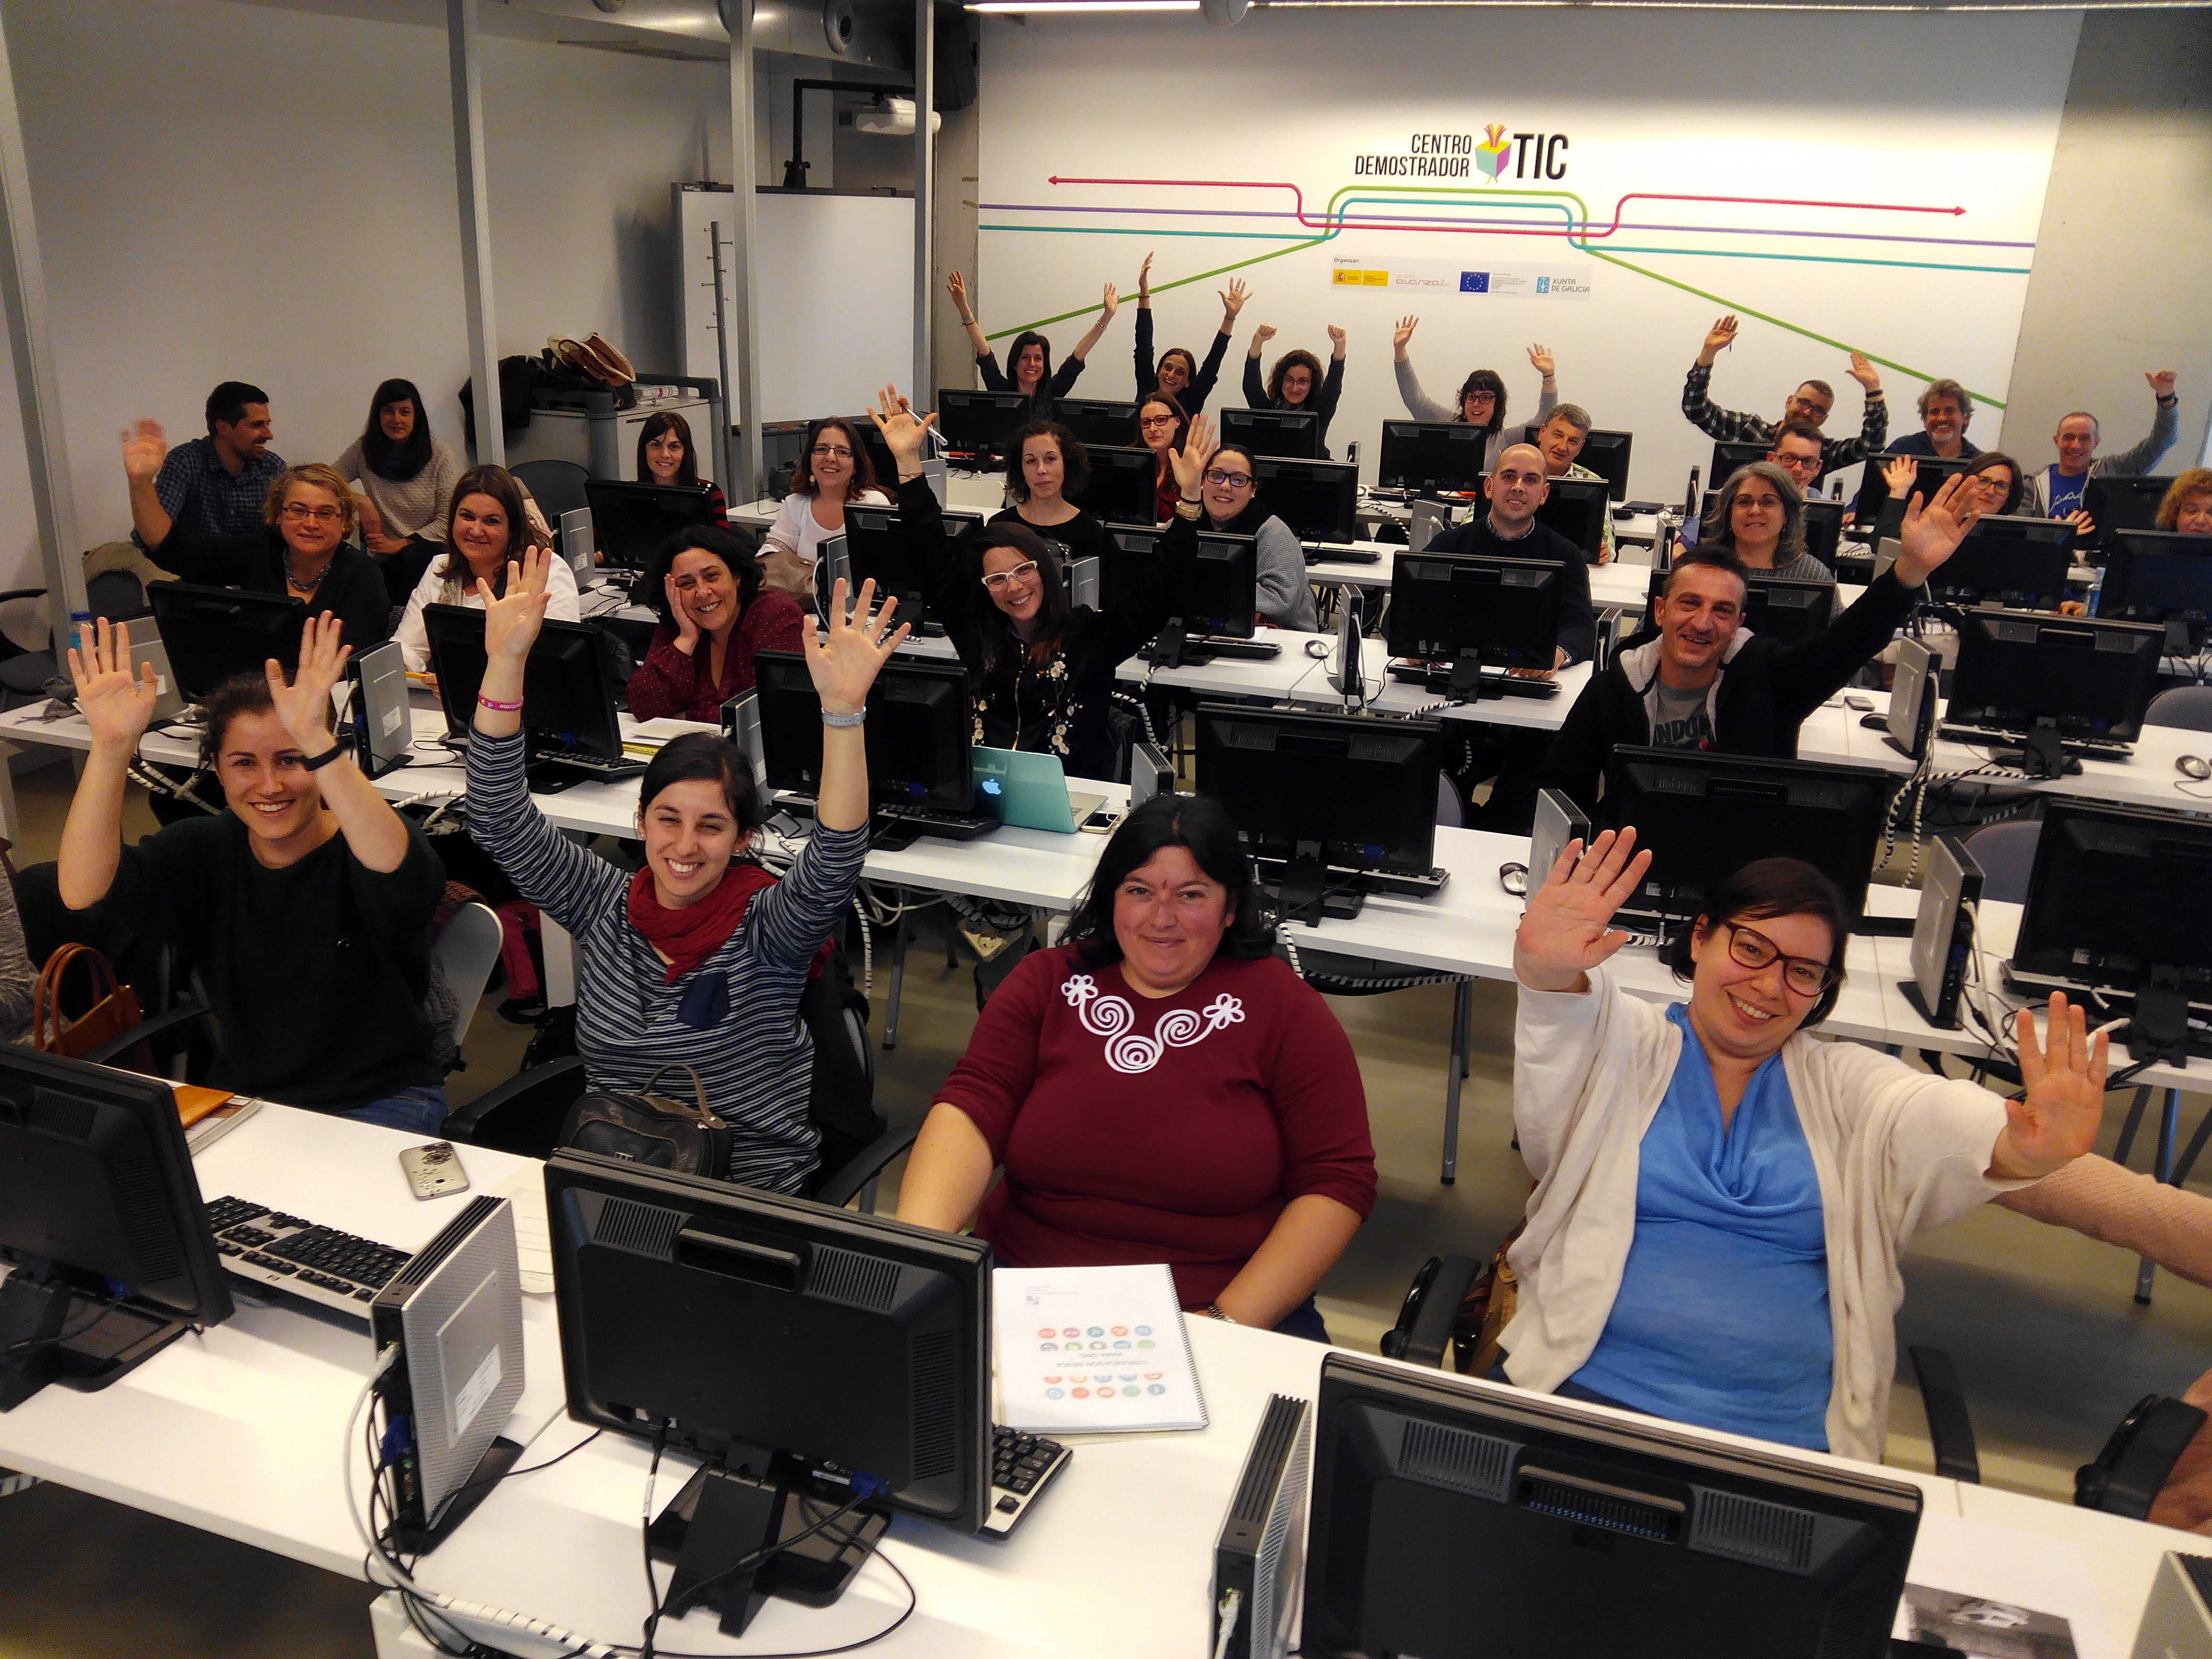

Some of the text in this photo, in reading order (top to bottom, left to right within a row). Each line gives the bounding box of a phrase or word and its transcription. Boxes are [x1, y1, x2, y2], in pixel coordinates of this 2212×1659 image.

[1411, 134, 1472, 155] CENTRO
[1513, 132, 1569, 180] TIC
[1355, 155, 1470, 178] DEMOSTRADOR
